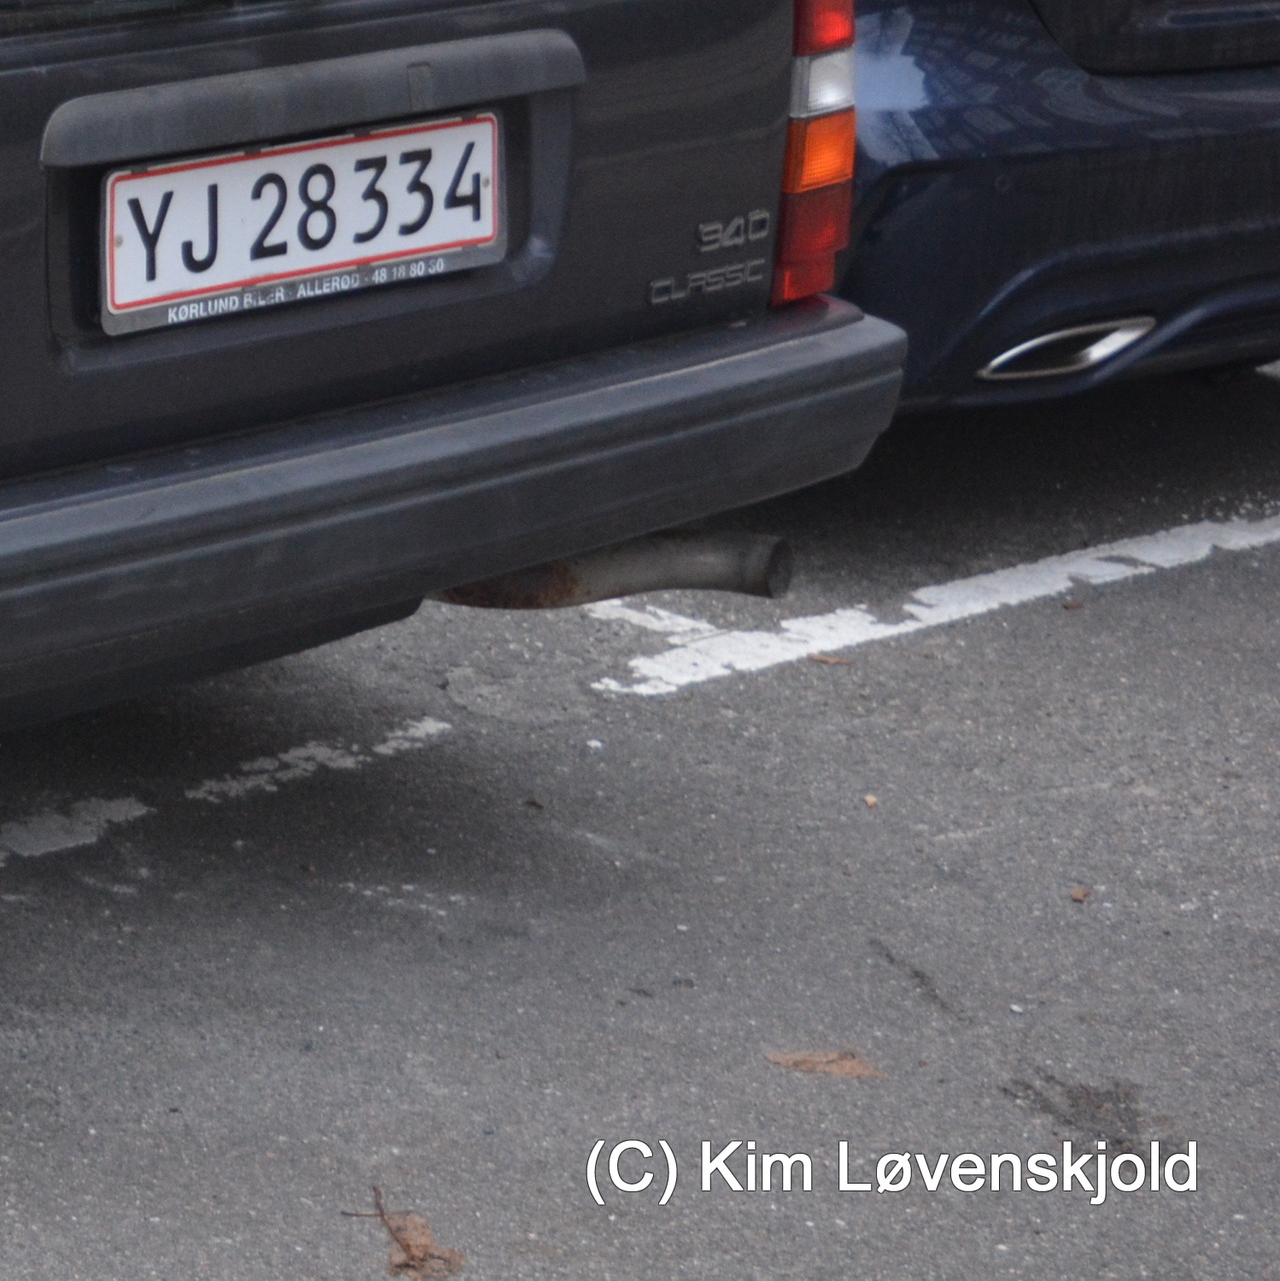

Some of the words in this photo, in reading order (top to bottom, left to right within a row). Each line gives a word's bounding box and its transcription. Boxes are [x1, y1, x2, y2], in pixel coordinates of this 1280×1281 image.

[126, 183, 220, 282] YJ
[698, 209, 770, 253] 940
[167, 294, 239, 324] KØRLUND
[371, 267, 388, 285] 48
[409, 260, 426, 278] 80
[650, 258, 766, 305] CLASSIC
